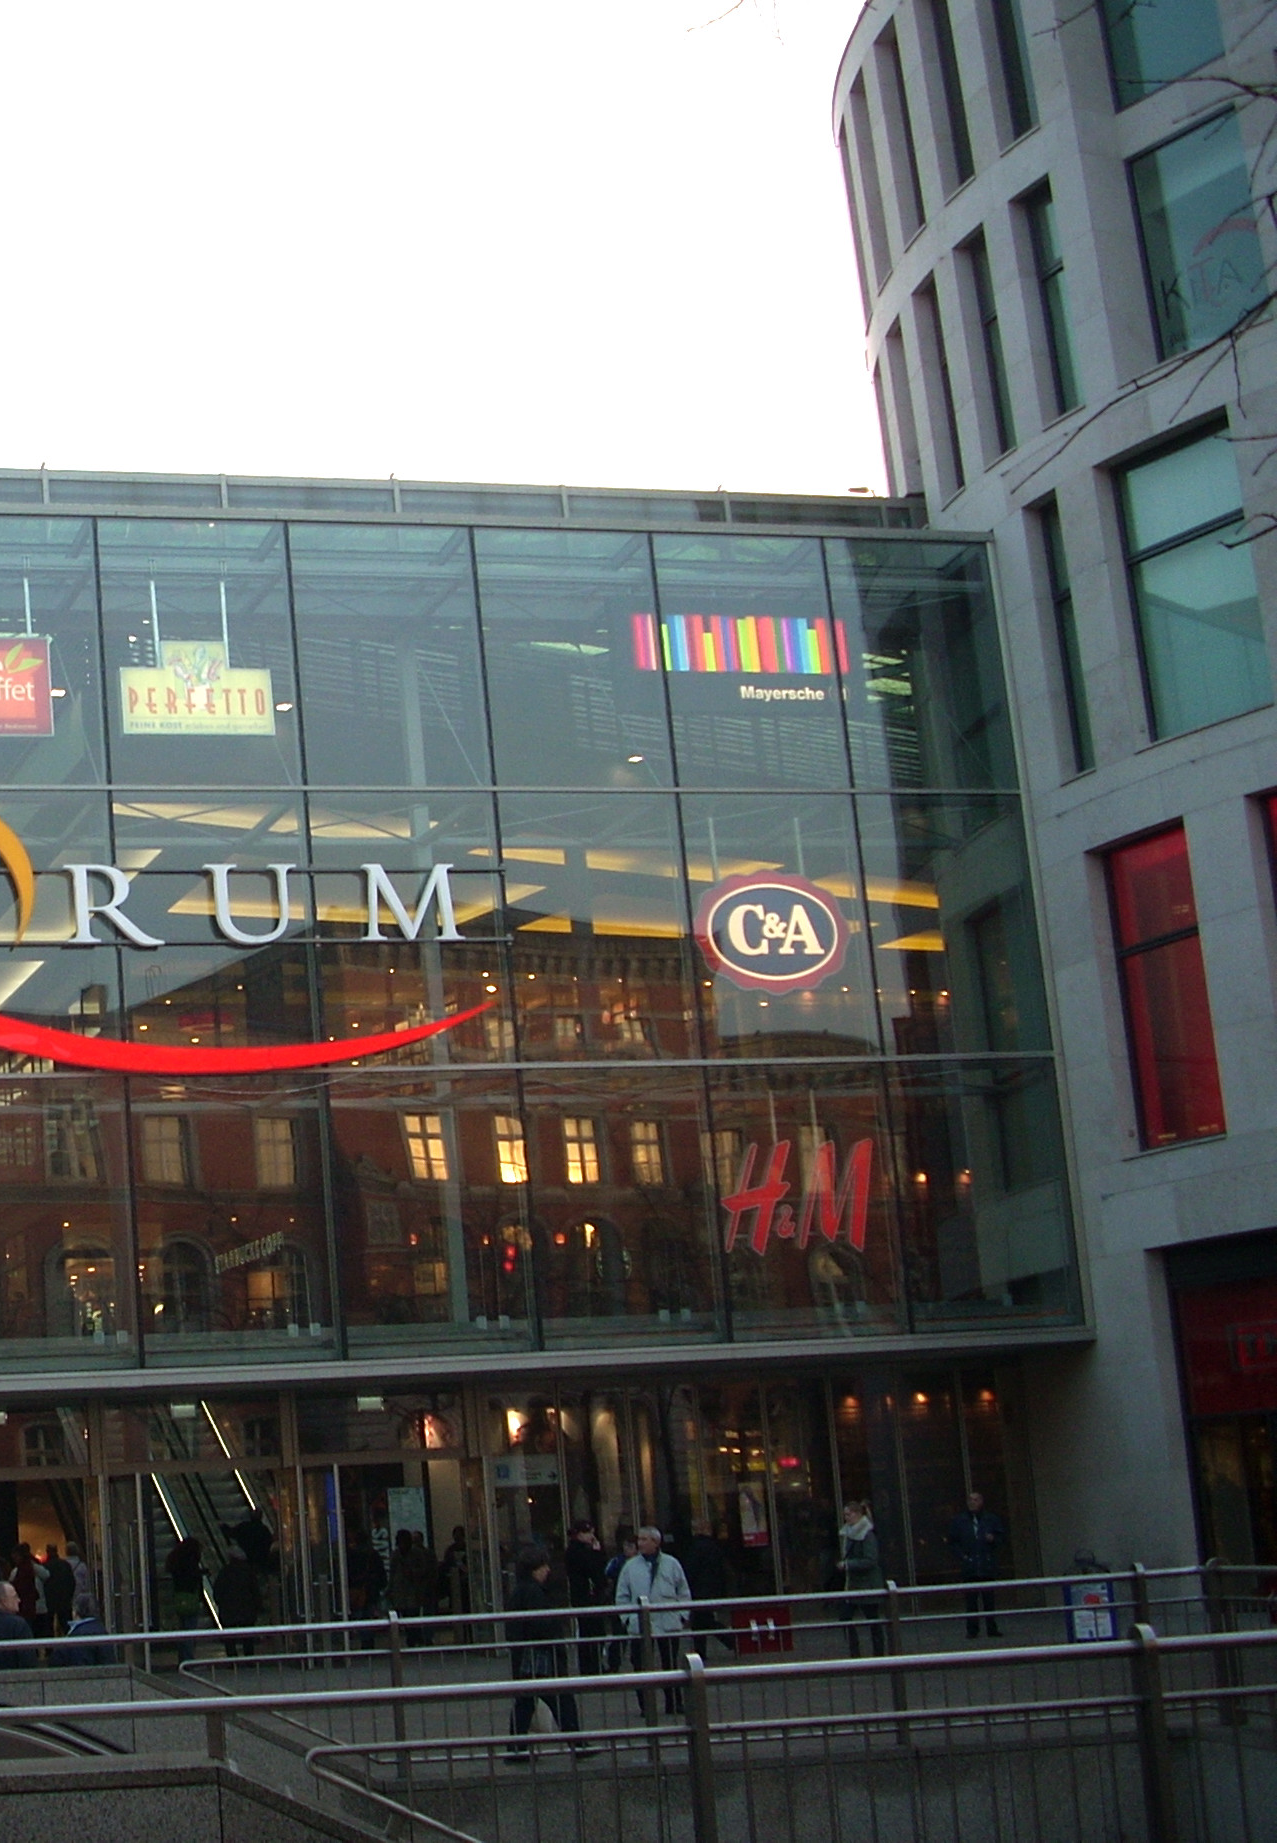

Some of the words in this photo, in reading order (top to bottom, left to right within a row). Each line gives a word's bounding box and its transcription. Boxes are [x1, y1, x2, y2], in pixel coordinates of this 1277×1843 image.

[127, 687, 266, 716] PERFETTO
[739, 684, 826, 703] Mayersche
[727, 903, 826, 956] C&A
[720, 1138, 874, 1257] H&M
